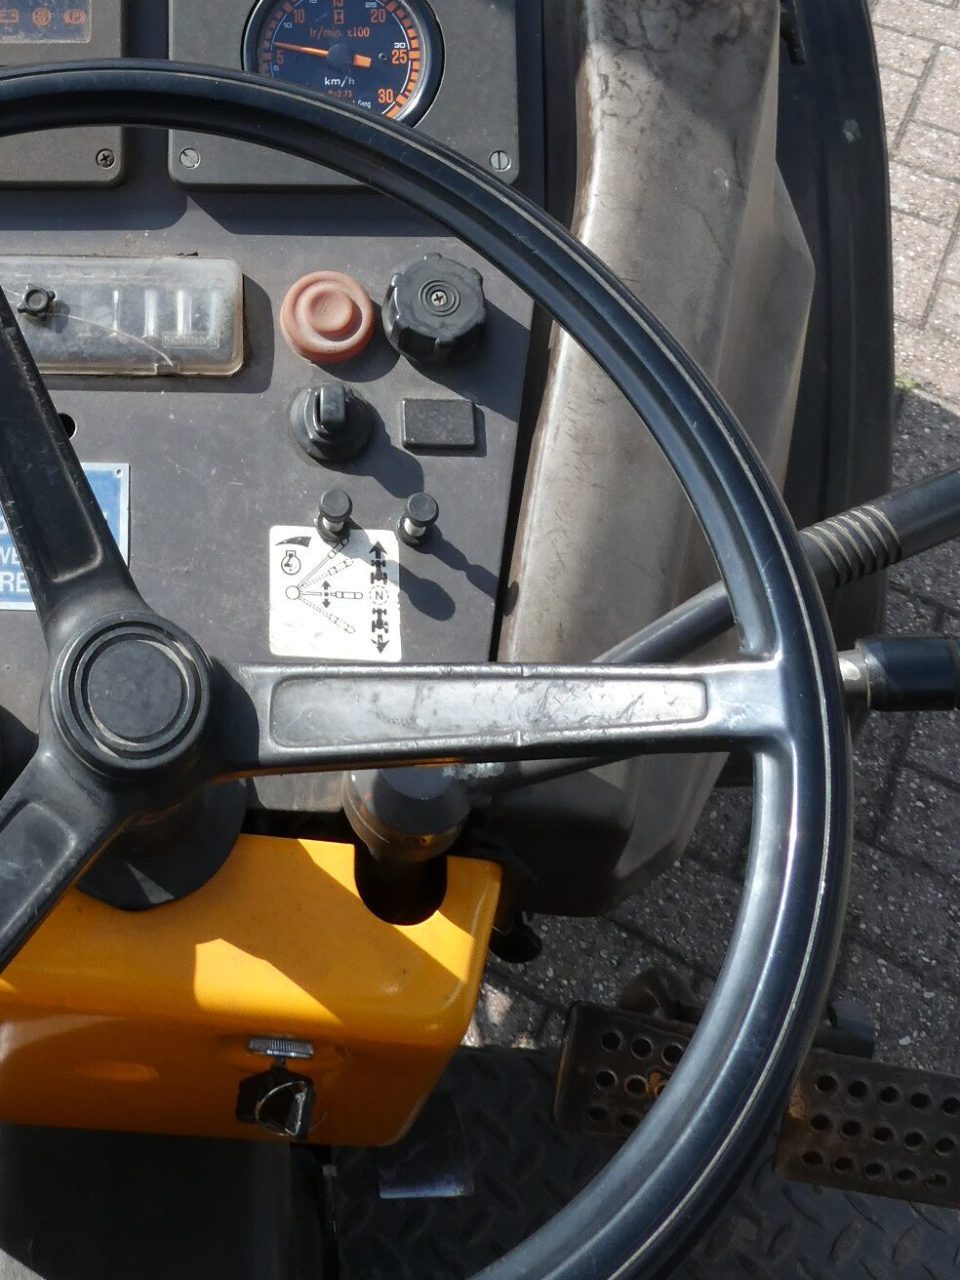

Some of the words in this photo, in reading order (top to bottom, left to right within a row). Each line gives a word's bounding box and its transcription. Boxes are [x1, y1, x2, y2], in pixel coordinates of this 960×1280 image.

[294, 10, 304, 23] 10
[371, 9, 386, 23] 20
[277, 50, 284, 64] 5
[392, 50, 407, 64] 25
[324, 76, 355, 87] km/h
[378, 88, 393, 103] 30
[375, 591, 384, 600] N
